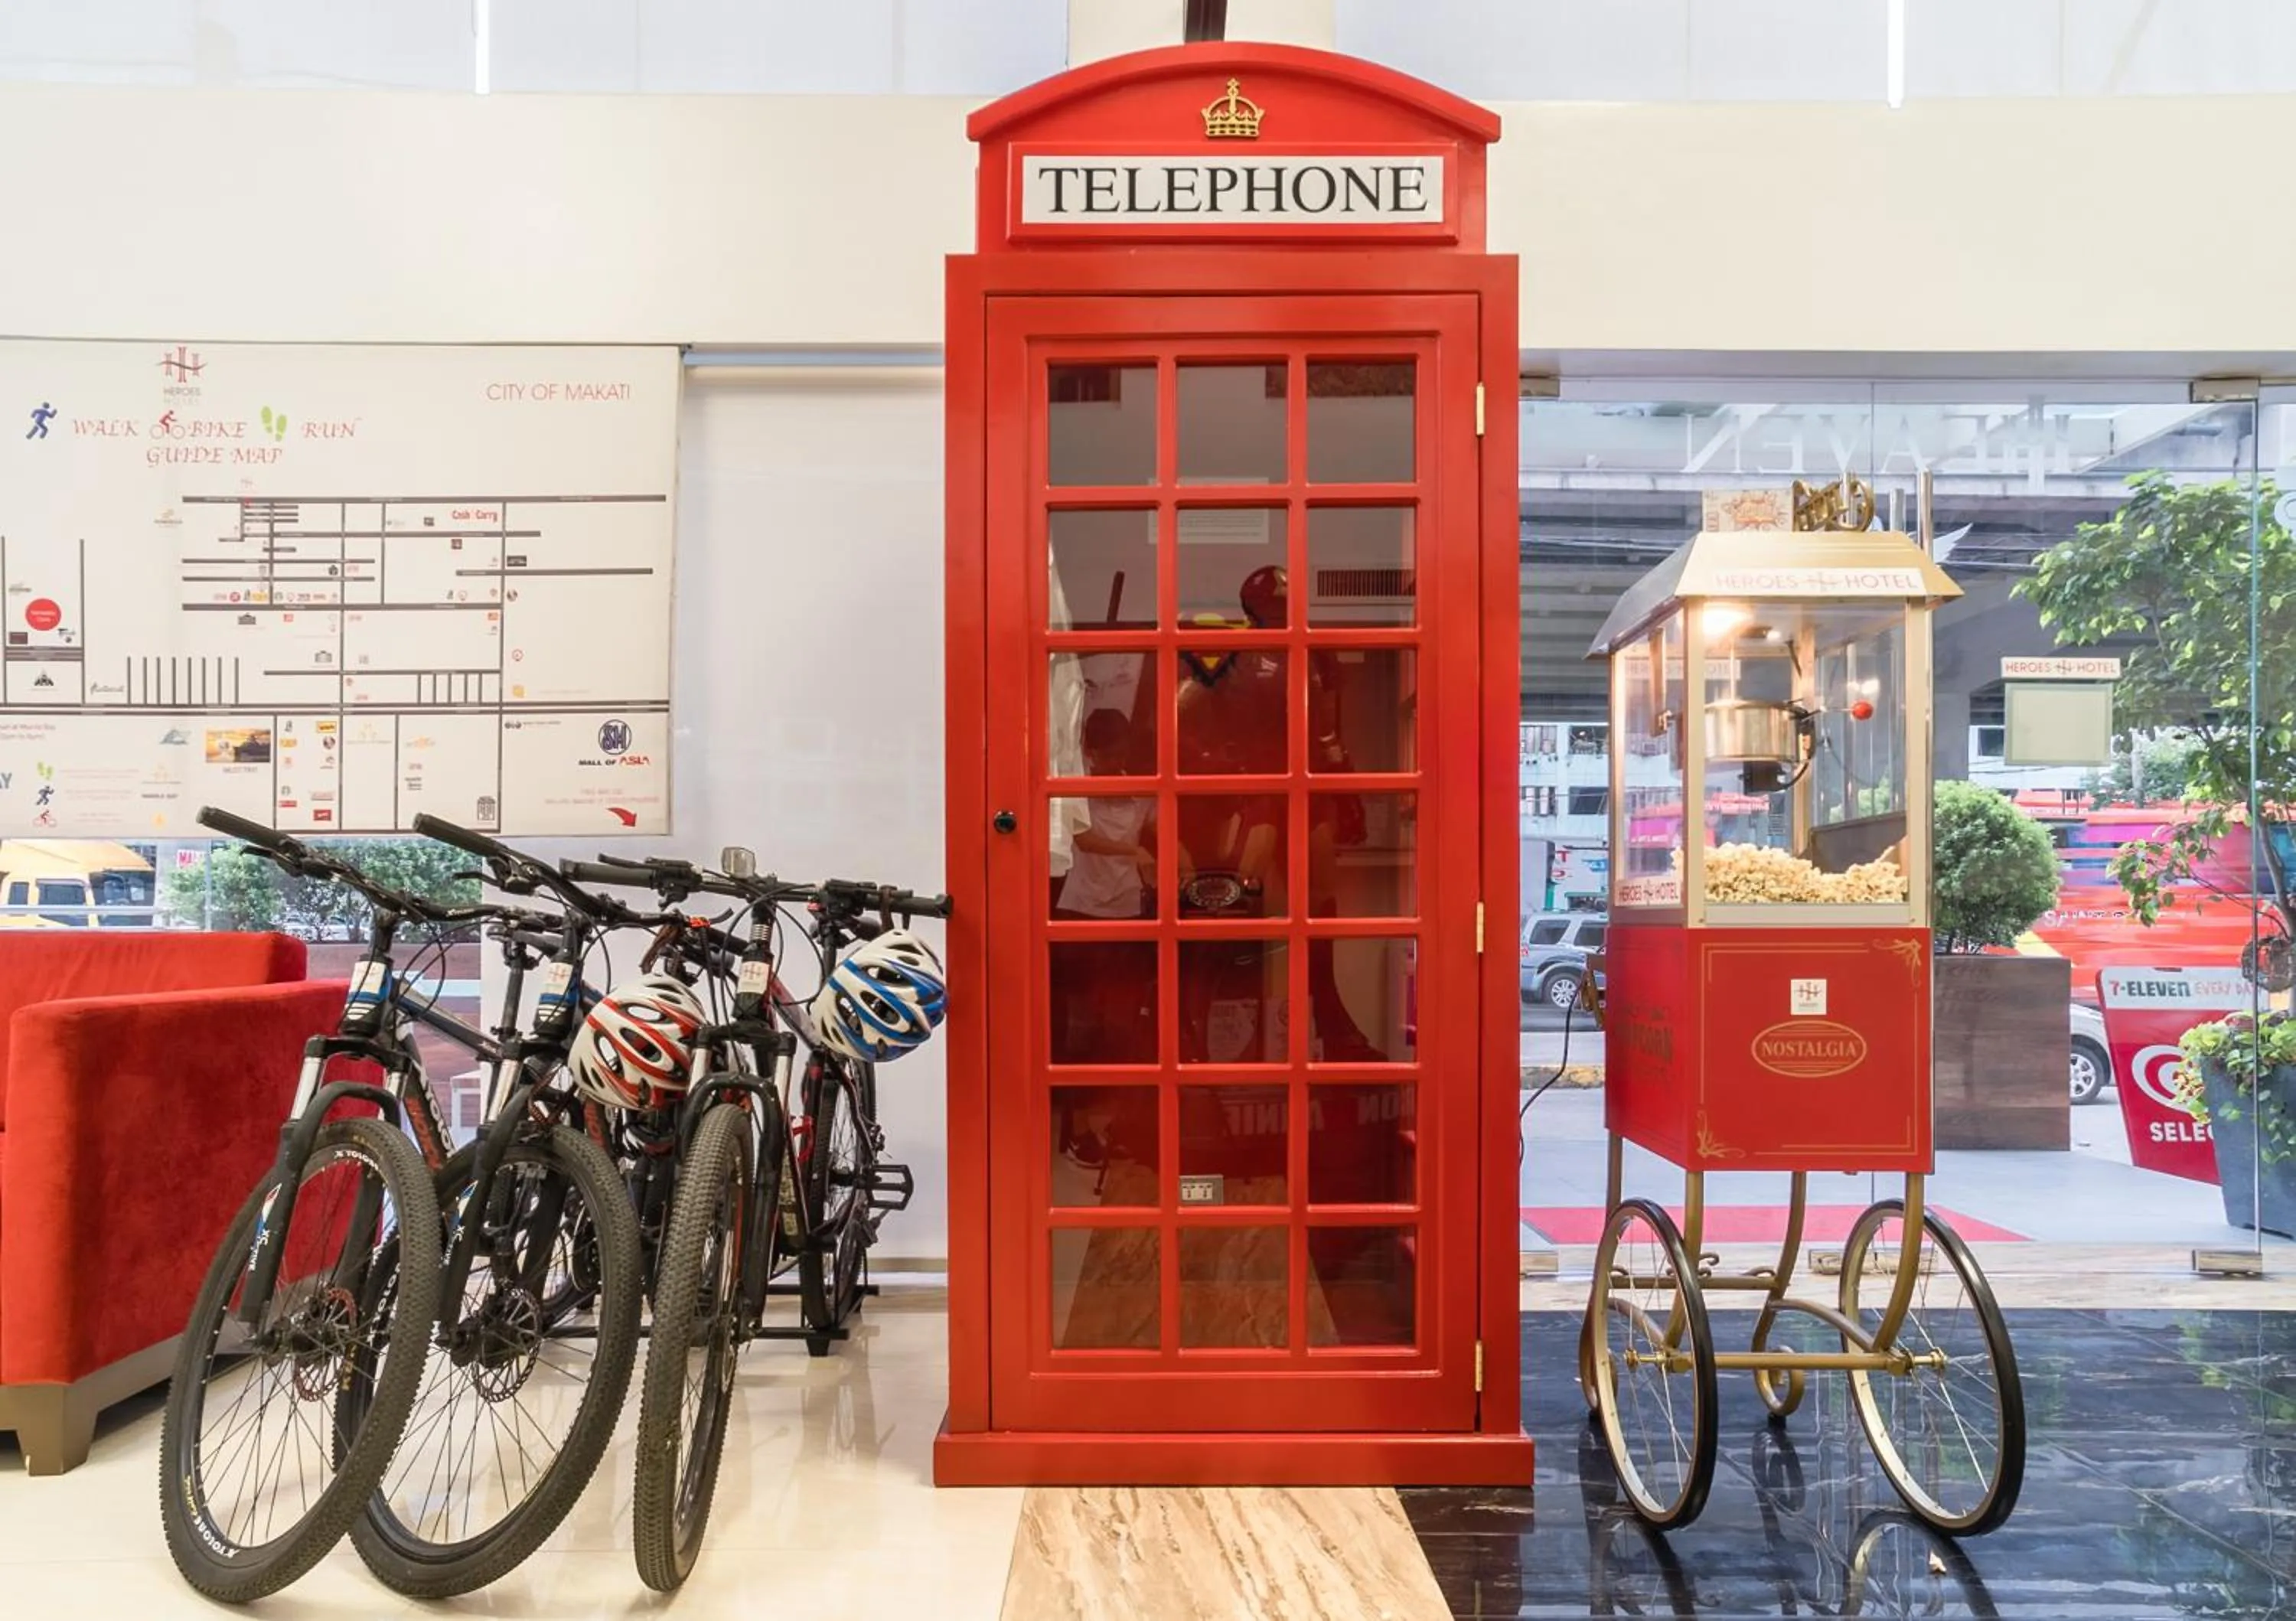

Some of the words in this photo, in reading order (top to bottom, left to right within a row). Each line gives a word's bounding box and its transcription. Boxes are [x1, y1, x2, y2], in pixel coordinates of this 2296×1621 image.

[1039, 166, 1428, 213] TELEPHONE
[163, 387, 201, 396] HEROES
[486, 383, 524, 401] CITY
[531, 383, 558, 401] OF
[566, 383, 630, 401] MAKATI
[73, 419, 140, 438] WALK
[190, 421, 247, 438] BIKE
[302, 420, 357, 439] RUN
[146, 446, 224, 468] GUIDE
[233, 447, 283, 464] MAP
[1715, 575, 1799, 589] HEROES
[1844, 575, 1919, 589] HOTEL
[2004, 661, 2051, 674] HEROES
[2078, 661, 2116, 674] HOTEL
[618, 755, 650, 765] ASIA
[1618, 885, 1643, 902] HEROES
[1655, 882, 1679, 900] HOTEL
[2109, 980, 2191, 996] 7-ELEVEN
[2194, 983, 2231, 995] EVERY
[1762, 1039, 1857, 1058] NOSTALGIA
